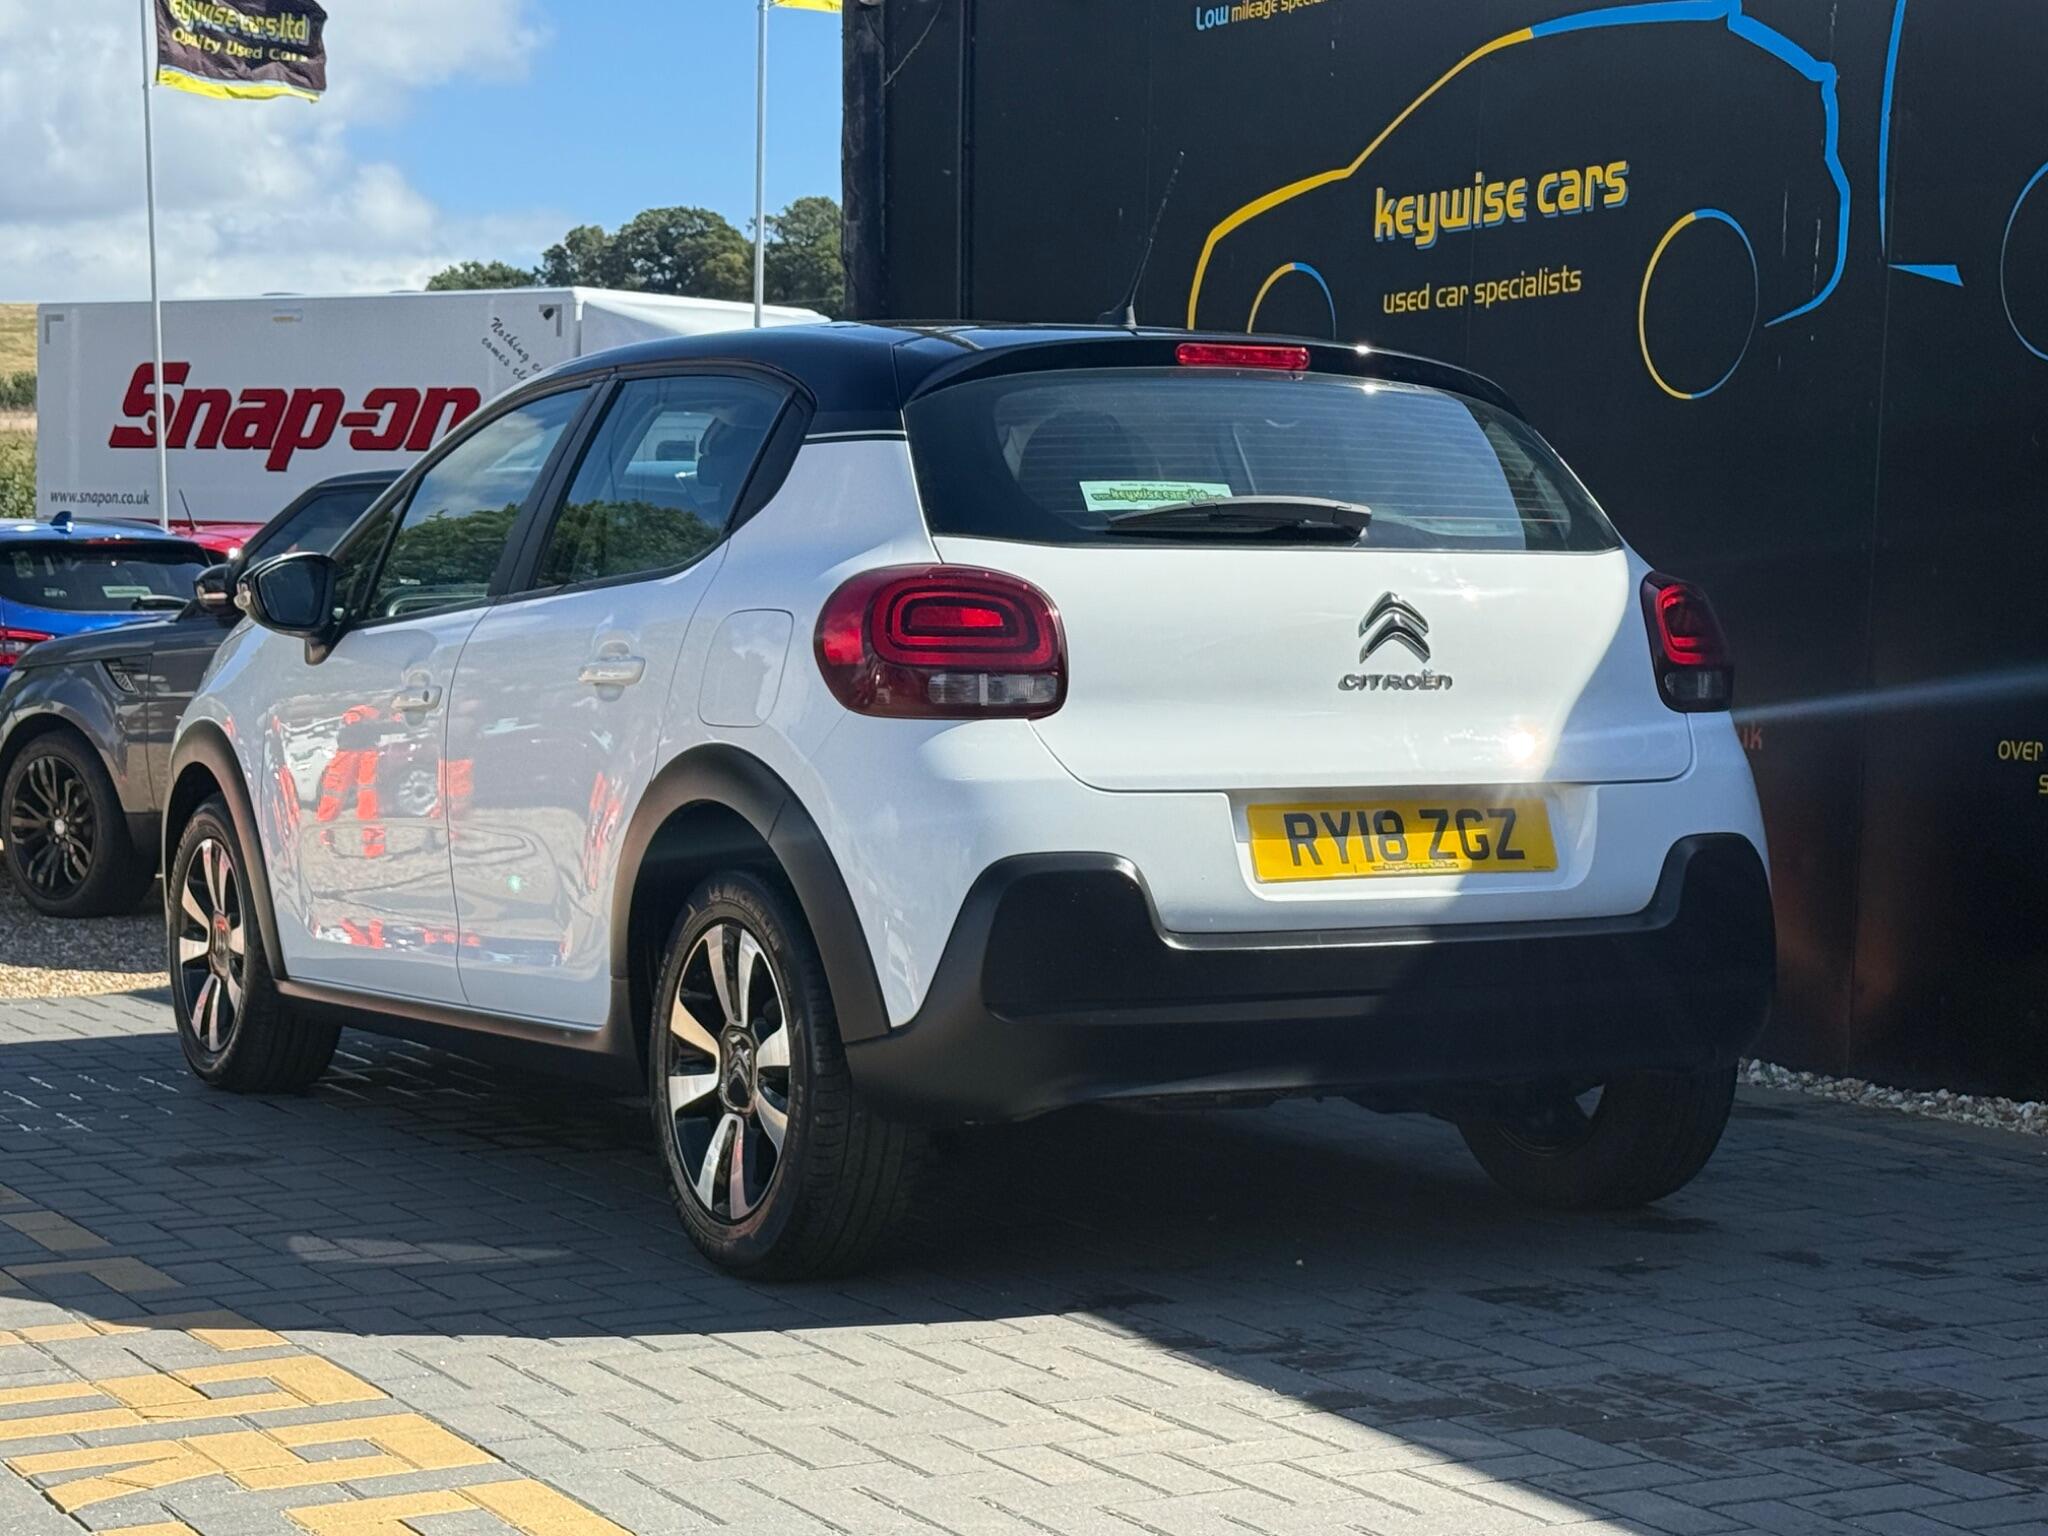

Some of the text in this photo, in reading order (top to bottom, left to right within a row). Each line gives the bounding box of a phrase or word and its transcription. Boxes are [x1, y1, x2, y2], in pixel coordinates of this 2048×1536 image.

[1196, 5, 1229, 31] Low
[226, 40, 263, 59] Used
[1374, 160, 1630, 250] keywise cars
[1383, 265, 1582, 314] used car specialists
[109, 362, 481, 472] Snap-on
[50, 489, 150, 507] www.snapon.co.uk
[1284, 808, 1526, 866] RY18 ZGZ
